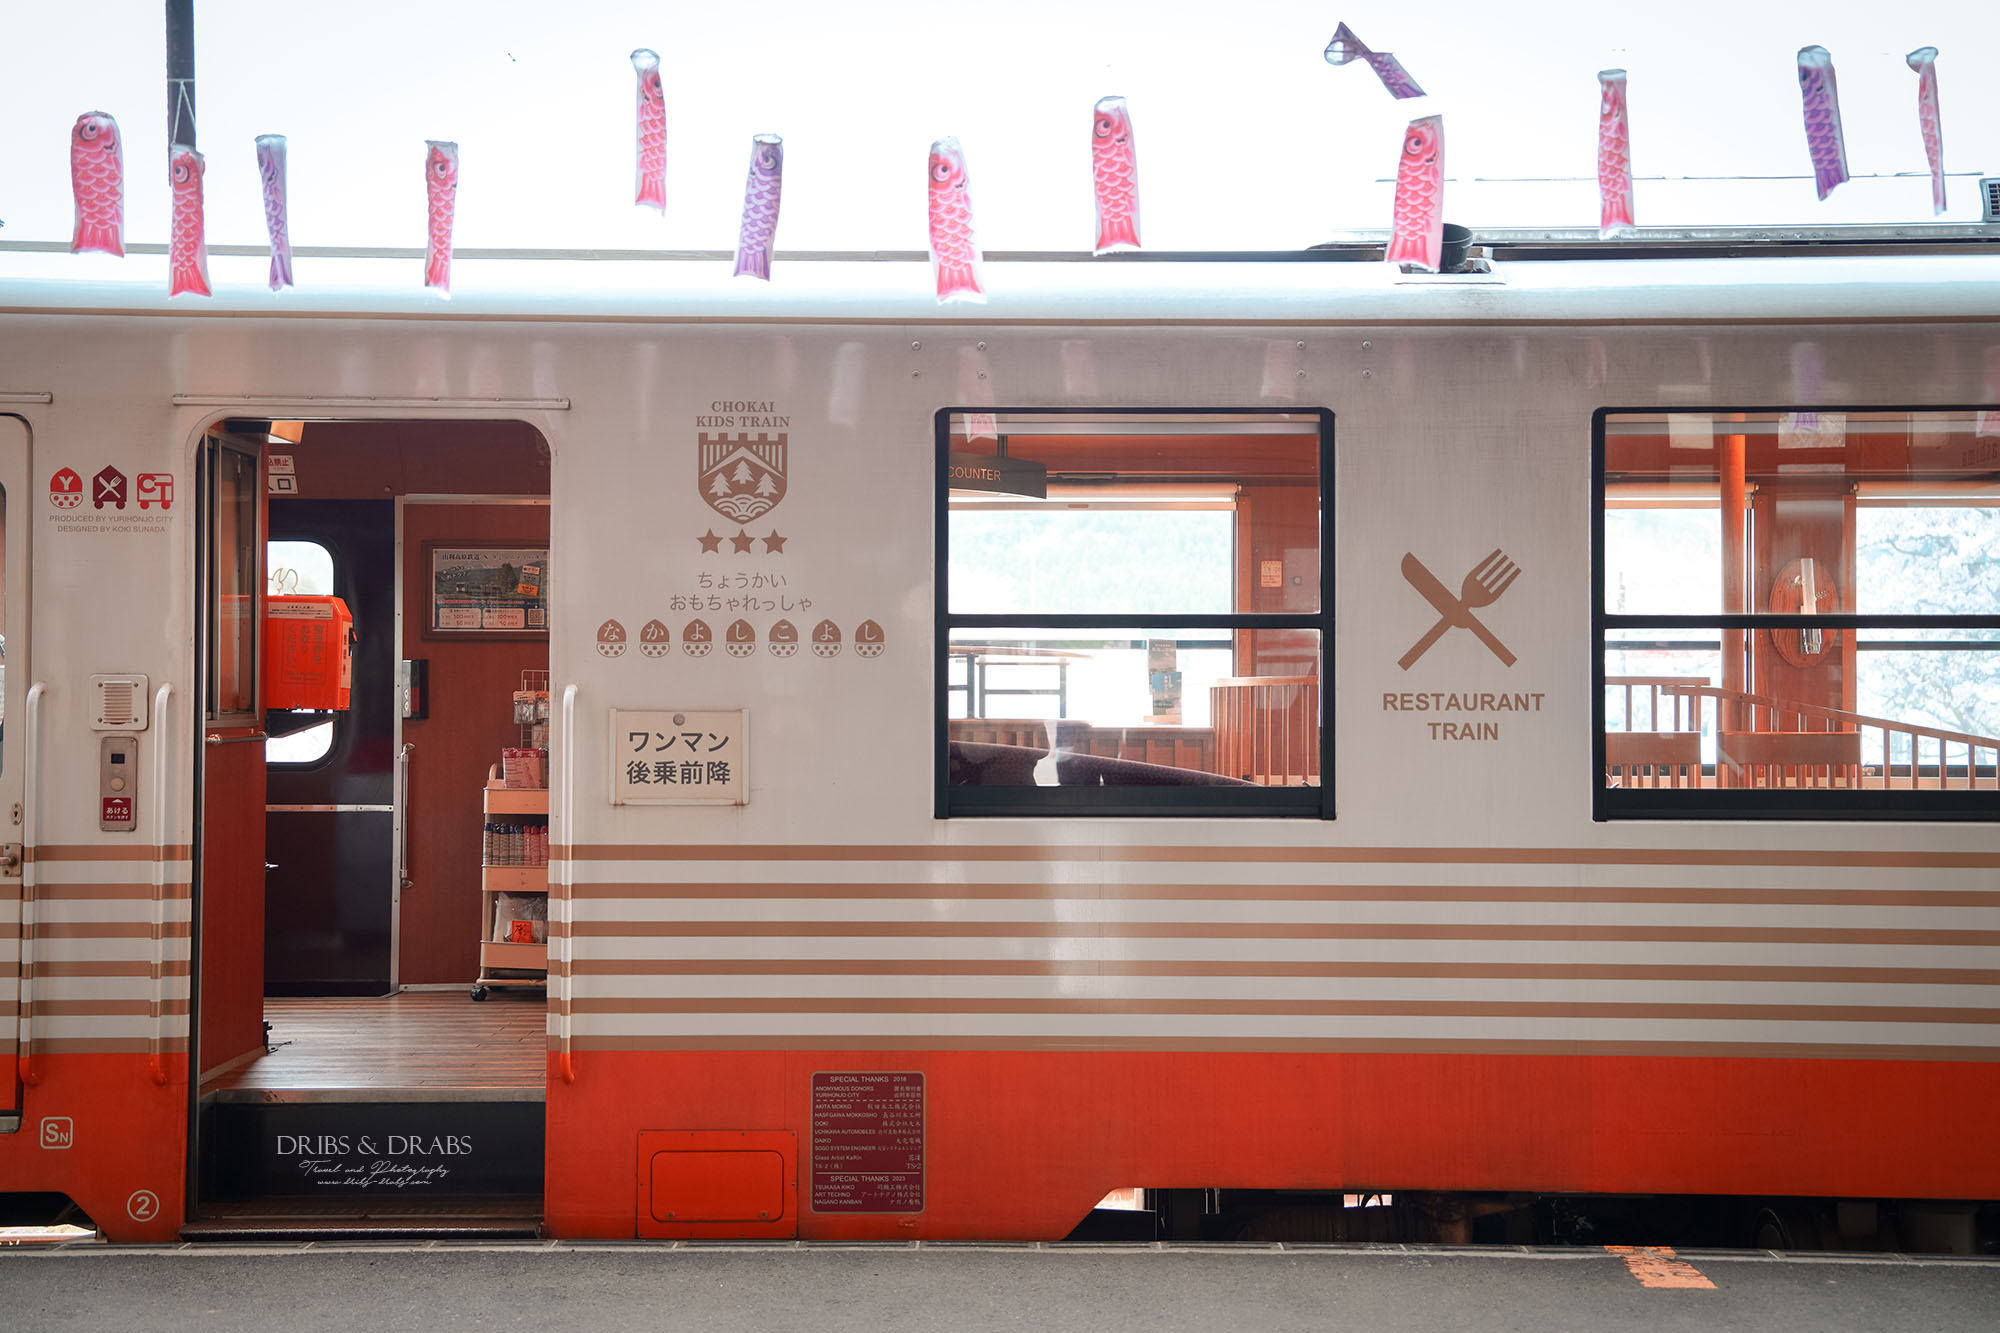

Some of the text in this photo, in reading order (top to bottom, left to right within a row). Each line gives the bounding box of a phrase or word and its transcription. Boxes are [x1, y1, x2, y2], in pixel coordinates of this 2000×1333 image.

[711, 401, 776, 412] CHOKAI
[696, 416, 791, 428] KIDS TRAIN
[949, 466, 1000, 480] COUNTER
[59, 476, 74, 490] Y
[698, 571, 787, 589] ちょうかい
[670, 594, 812, 612] おもちゃれっしゃ
[1383, 693, 1545, 711] RESTAURANT
[1428, 722, 1499, 741] TRAIN
[629, 732, 729, 752] ワンマン
[626, 760, 730, 785] 後乗前降
[136, 1196, 150, 1215] 2
